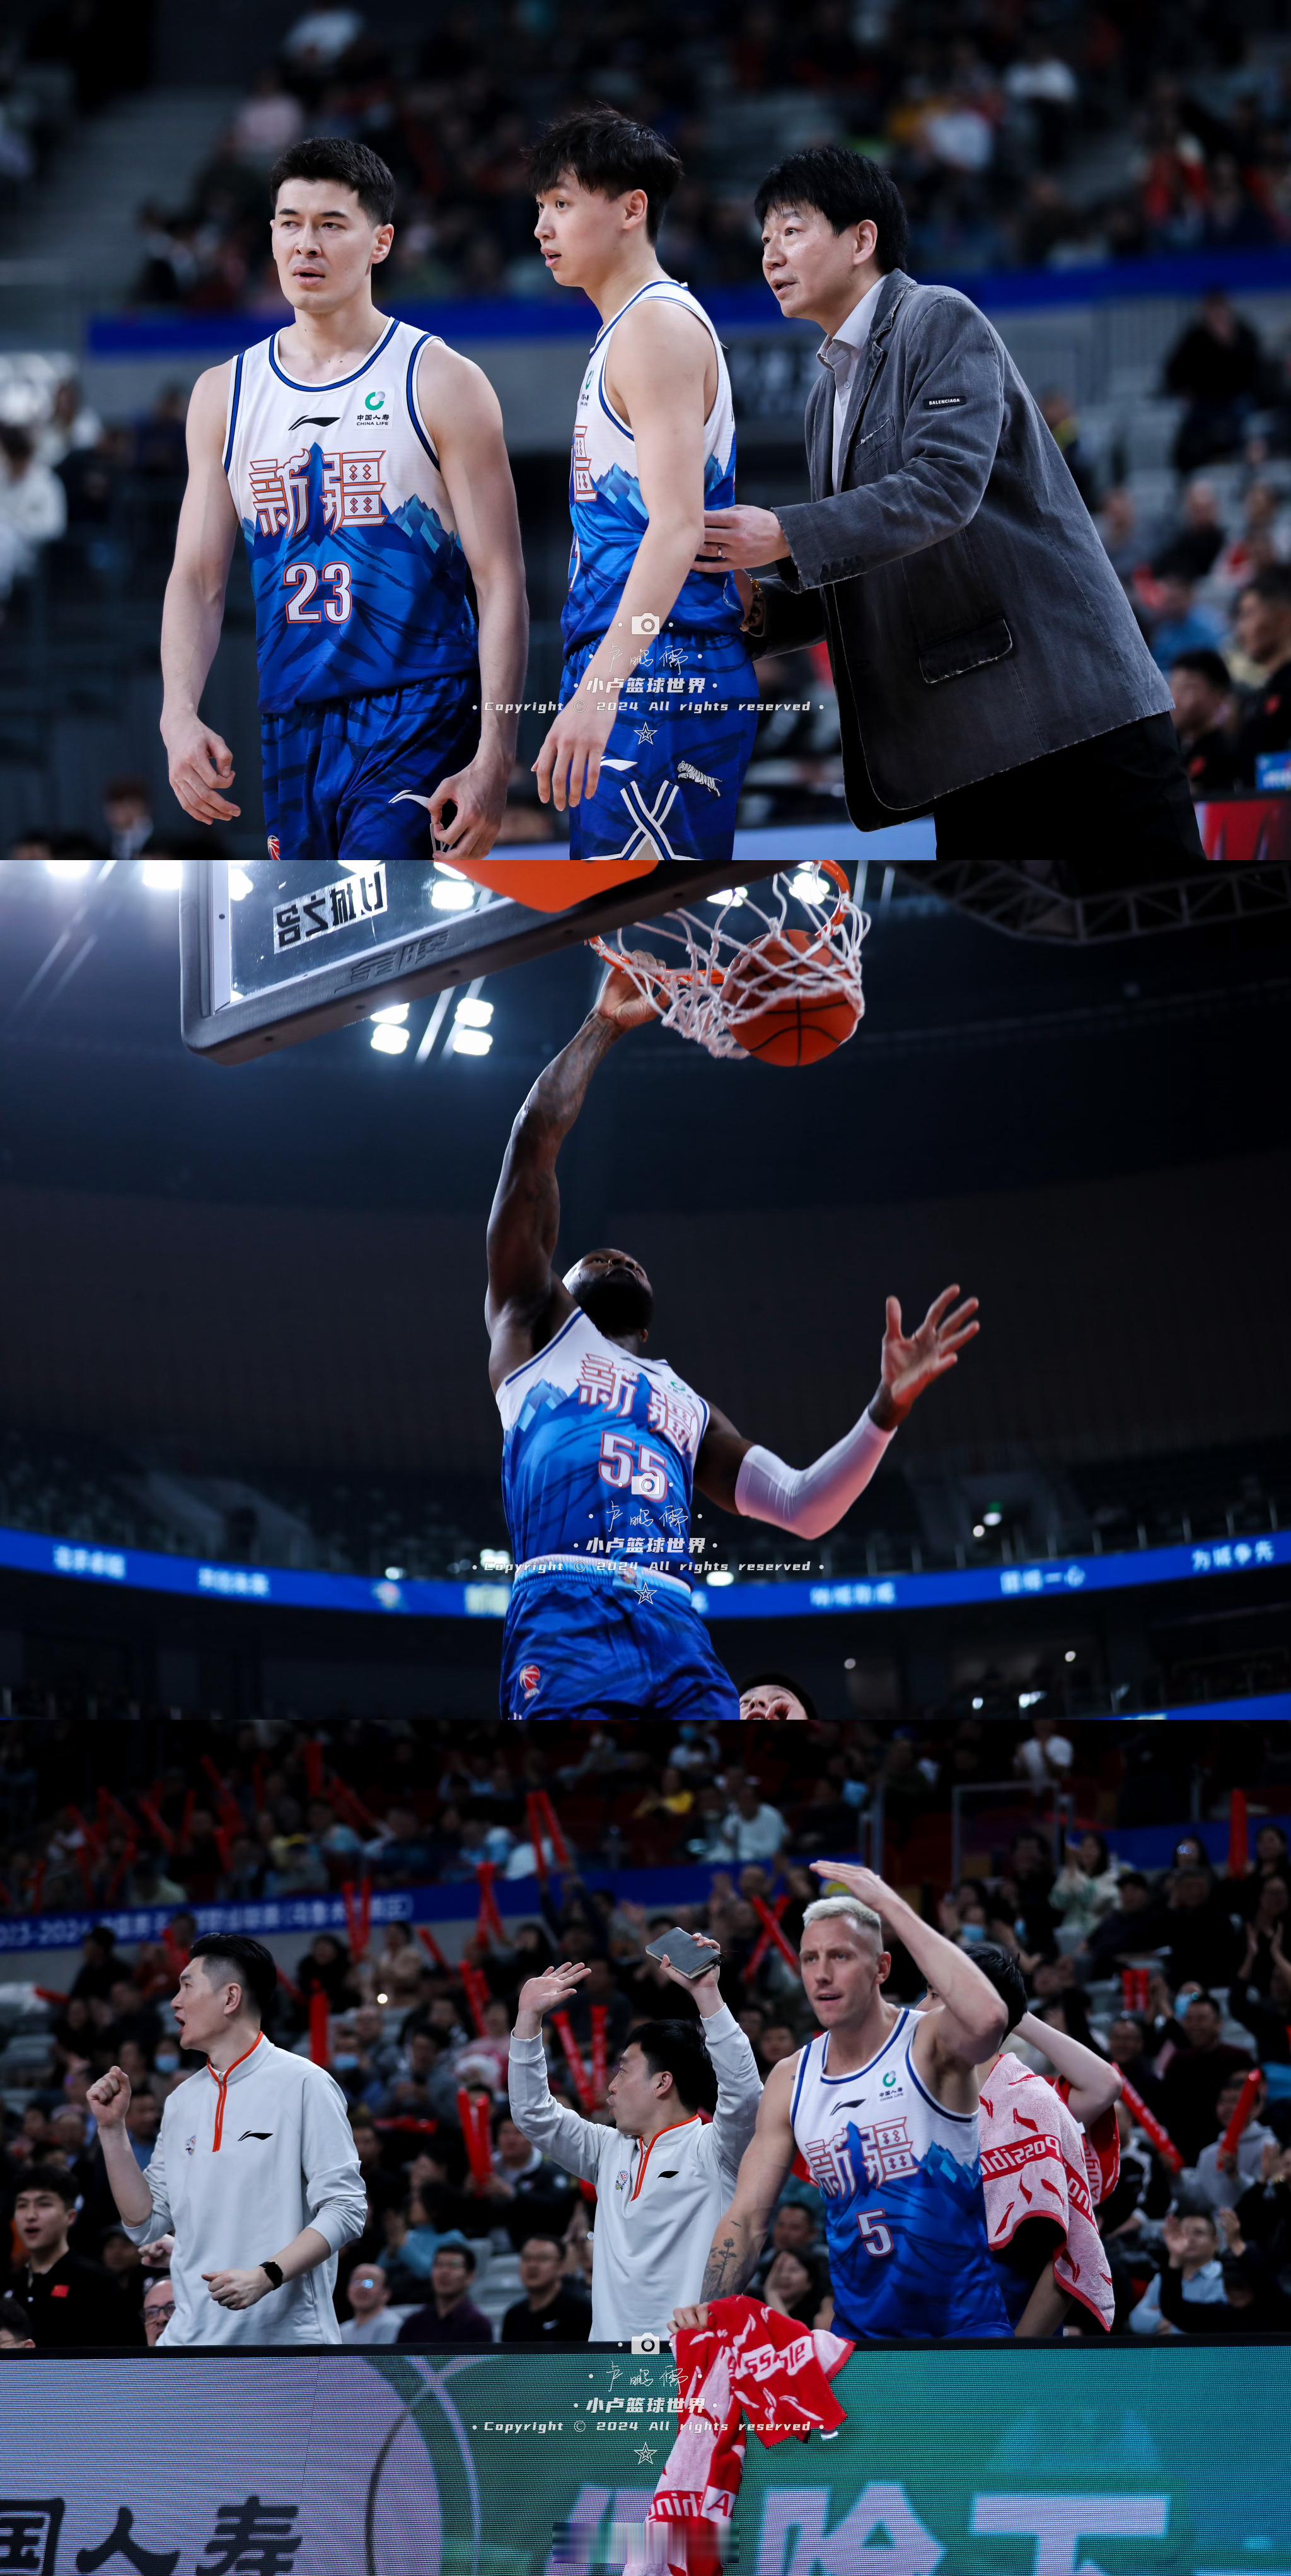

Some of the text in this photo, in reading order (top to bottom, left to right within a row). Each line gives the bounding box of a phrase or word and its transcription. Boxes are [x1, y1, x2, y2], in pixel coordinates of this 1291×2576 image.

[248, 448, 388, 538] 新疆
[283, 561, 353, 624] 23
[576, 1353, 695, 1455] 新疆
[598, 1431, 667, 1503] 55
[804, 2116, 920, 2200] 新疆
[856, 2208, 894, 2257] 5
